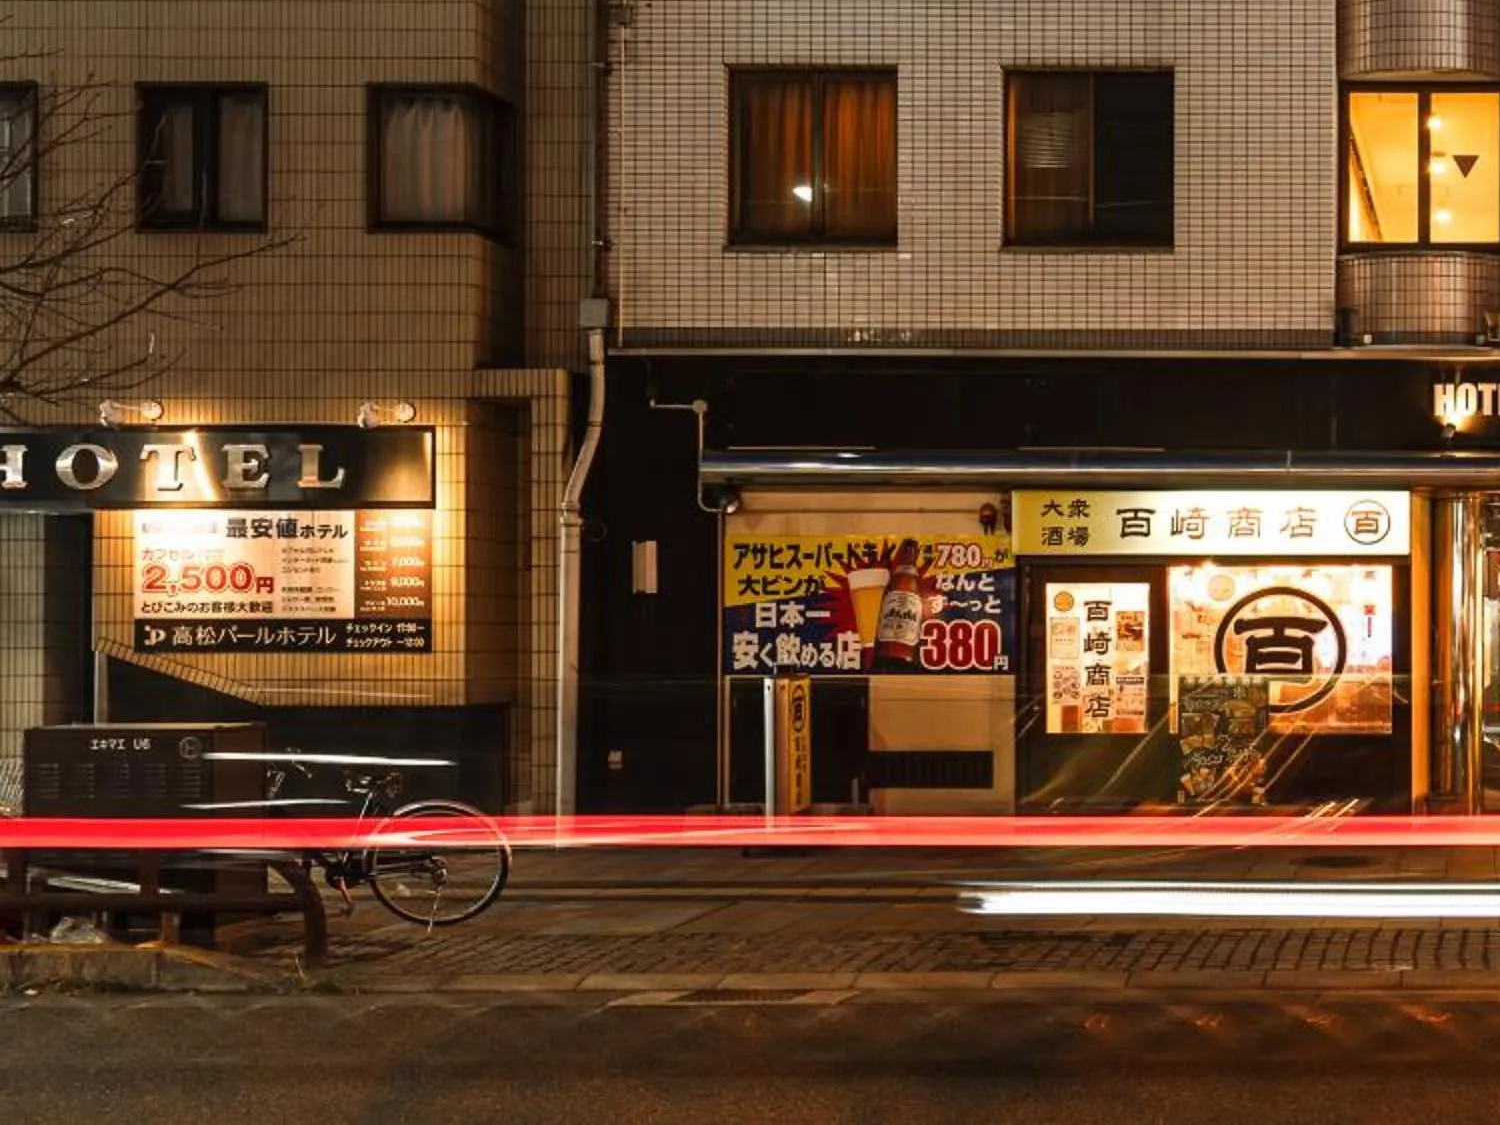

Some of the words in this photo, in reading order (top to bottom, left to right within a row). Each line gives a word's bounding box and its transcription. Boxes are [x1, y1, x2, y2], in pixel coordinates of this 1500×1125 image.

[1041, 499, 1091, 518] 大衆
[226, 518, 348, 539] 最安値ホテル
[1041, 526, 1091, 547] 酒場
[142, 562, 275, 596] 2,500円
[936, 572, 995, 592] なんと
[755, 603, 831, 628] 日本一
[172, 626, 337, 646] 高松パールホテル
[920, 619, 1009, 670] 380円
[1234, 616, 1329, 675] 百
[733, 632, 862, 670] 安く飲める店
